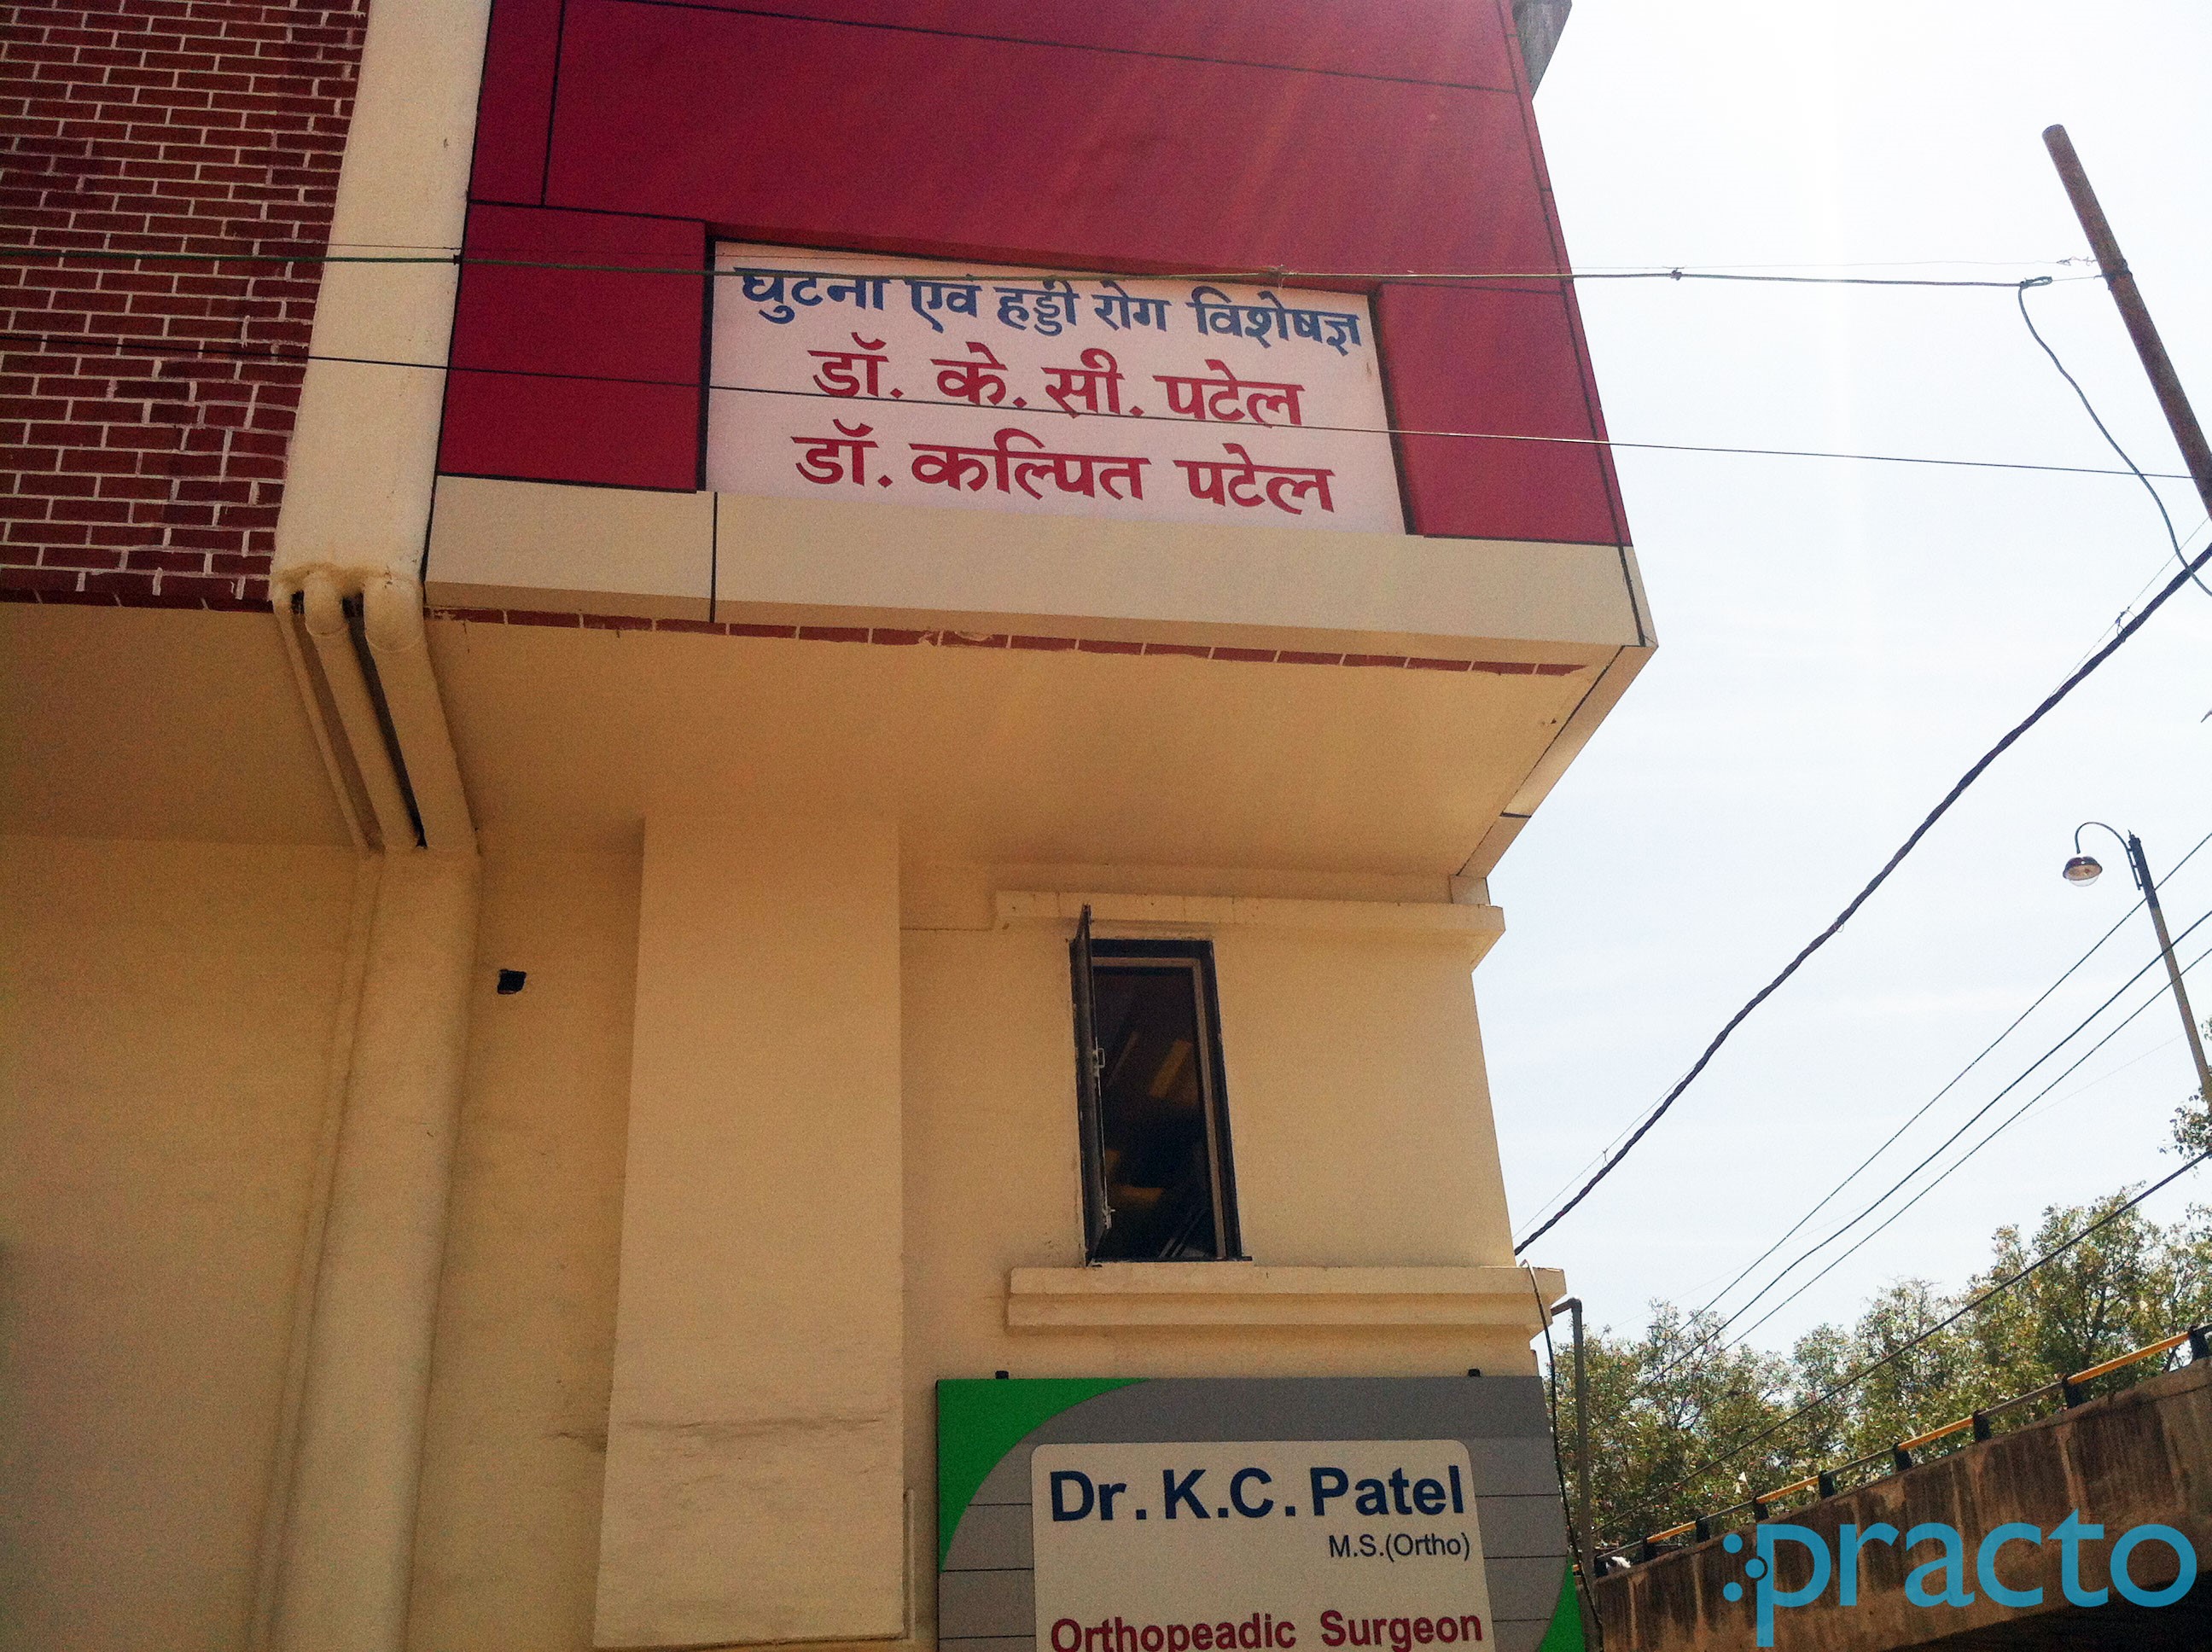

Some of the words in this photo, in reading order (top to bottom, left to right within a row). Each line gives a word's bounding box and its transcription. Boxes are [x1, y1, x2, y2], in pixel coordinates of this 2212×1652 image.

[733, 266, 892, 324] घुटना
[992, 278, 1080, 336] हड्डी
[1091, 279, 1172, 332] रोग
[1185, 286, 1361, 357] विशेषज्ञ
[806, 332, 904, 399] डॉ.
[1152, 358, 1306, 428] पटेल
[790, 418, 893, 488] डॉ.
[908, 428, 1152, 501] कल्पित
[1173, 443, 1336, 515] पटेल
[1050, 1469, 1147, 1522] Dr.
[1309, 1464, 1465, 1516] Patel
[1328, 1533, 1471, 1562] M.S.(Ortho)
[1051, 1612, 1297, 1652] Orthopeadic
[1319, 1609, 1485, 1652] Surgeon
